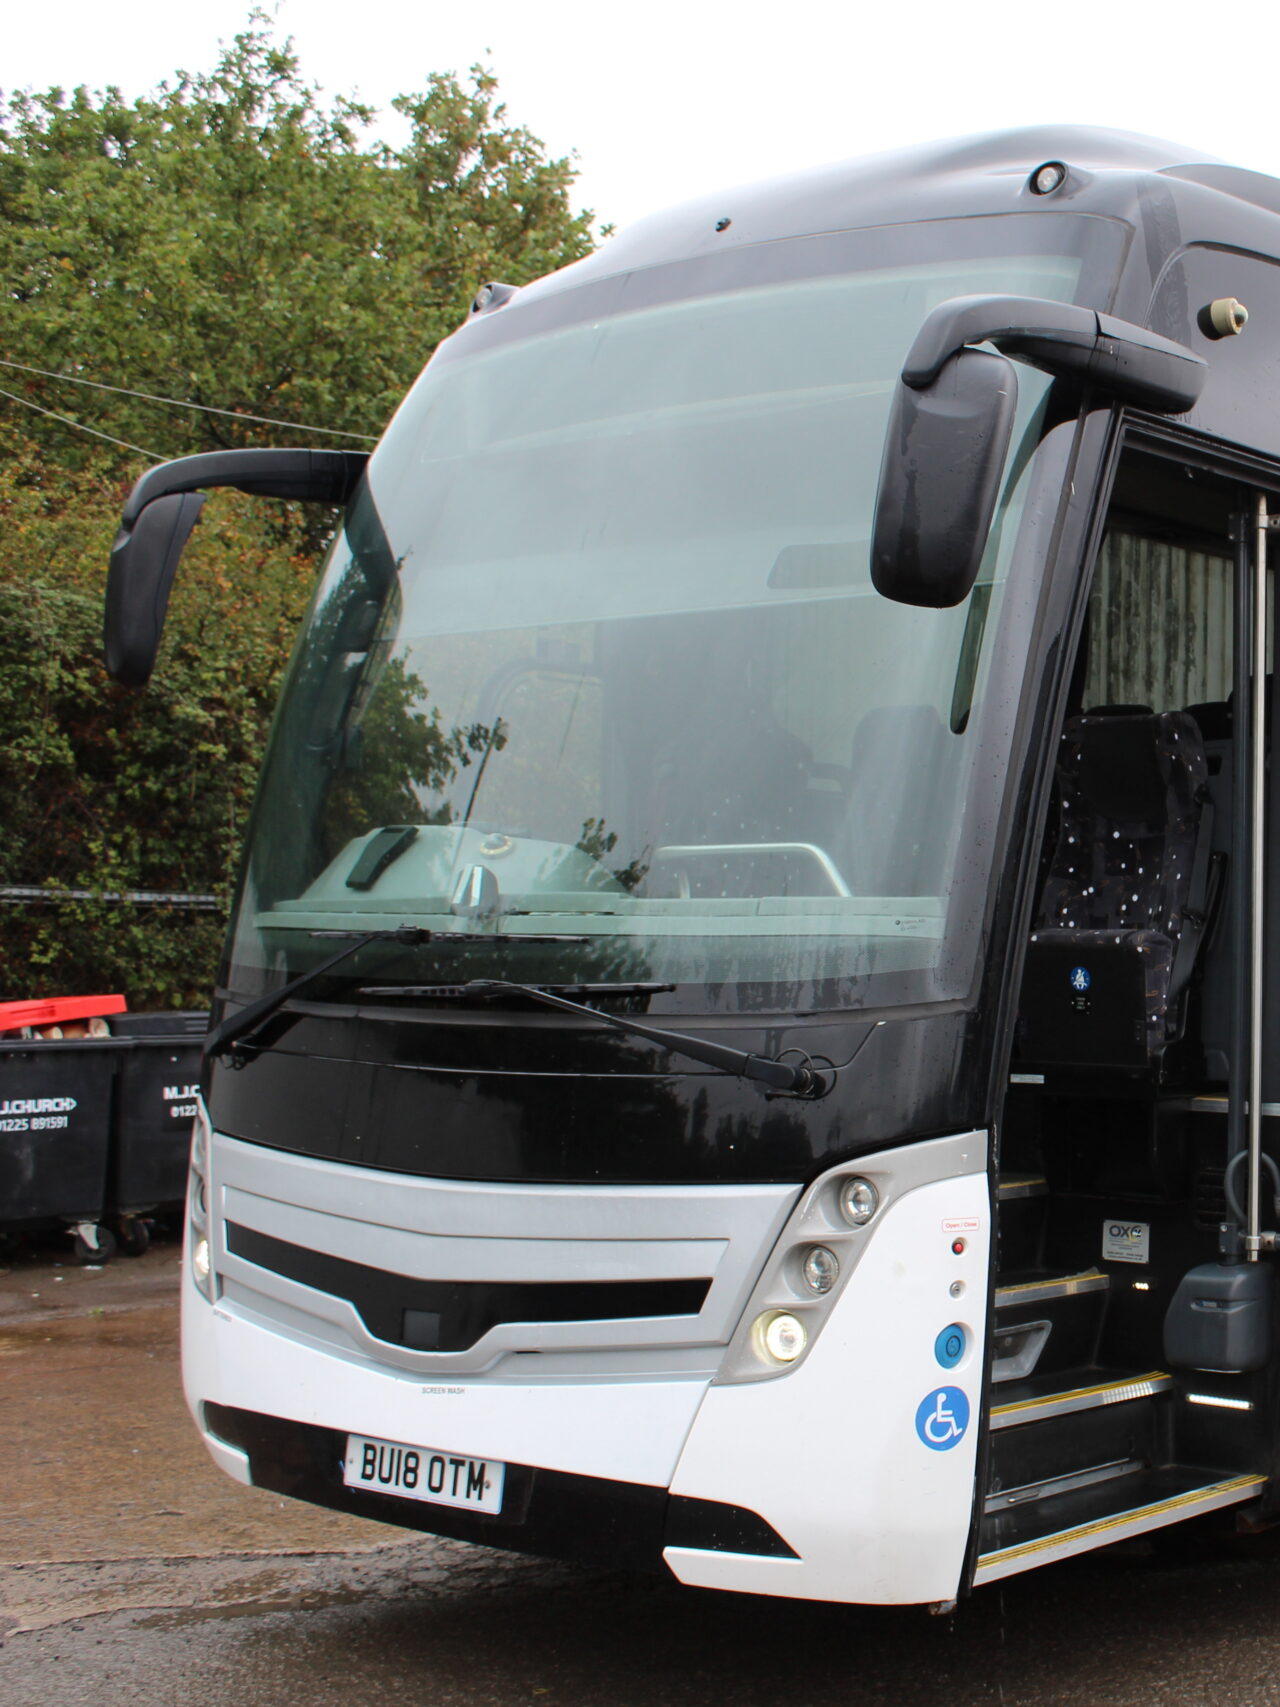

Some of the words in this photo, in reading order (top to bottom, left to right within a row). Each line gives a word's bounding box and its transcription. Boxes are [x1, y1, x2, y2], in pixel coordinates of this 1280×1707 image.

[0, 1119, 29, 1131] 1225
[30, 1116, 68, 1130] 891591
[361, 1443, 420, 1488] BU18
[428, 1456, 486, 1501] OTM
